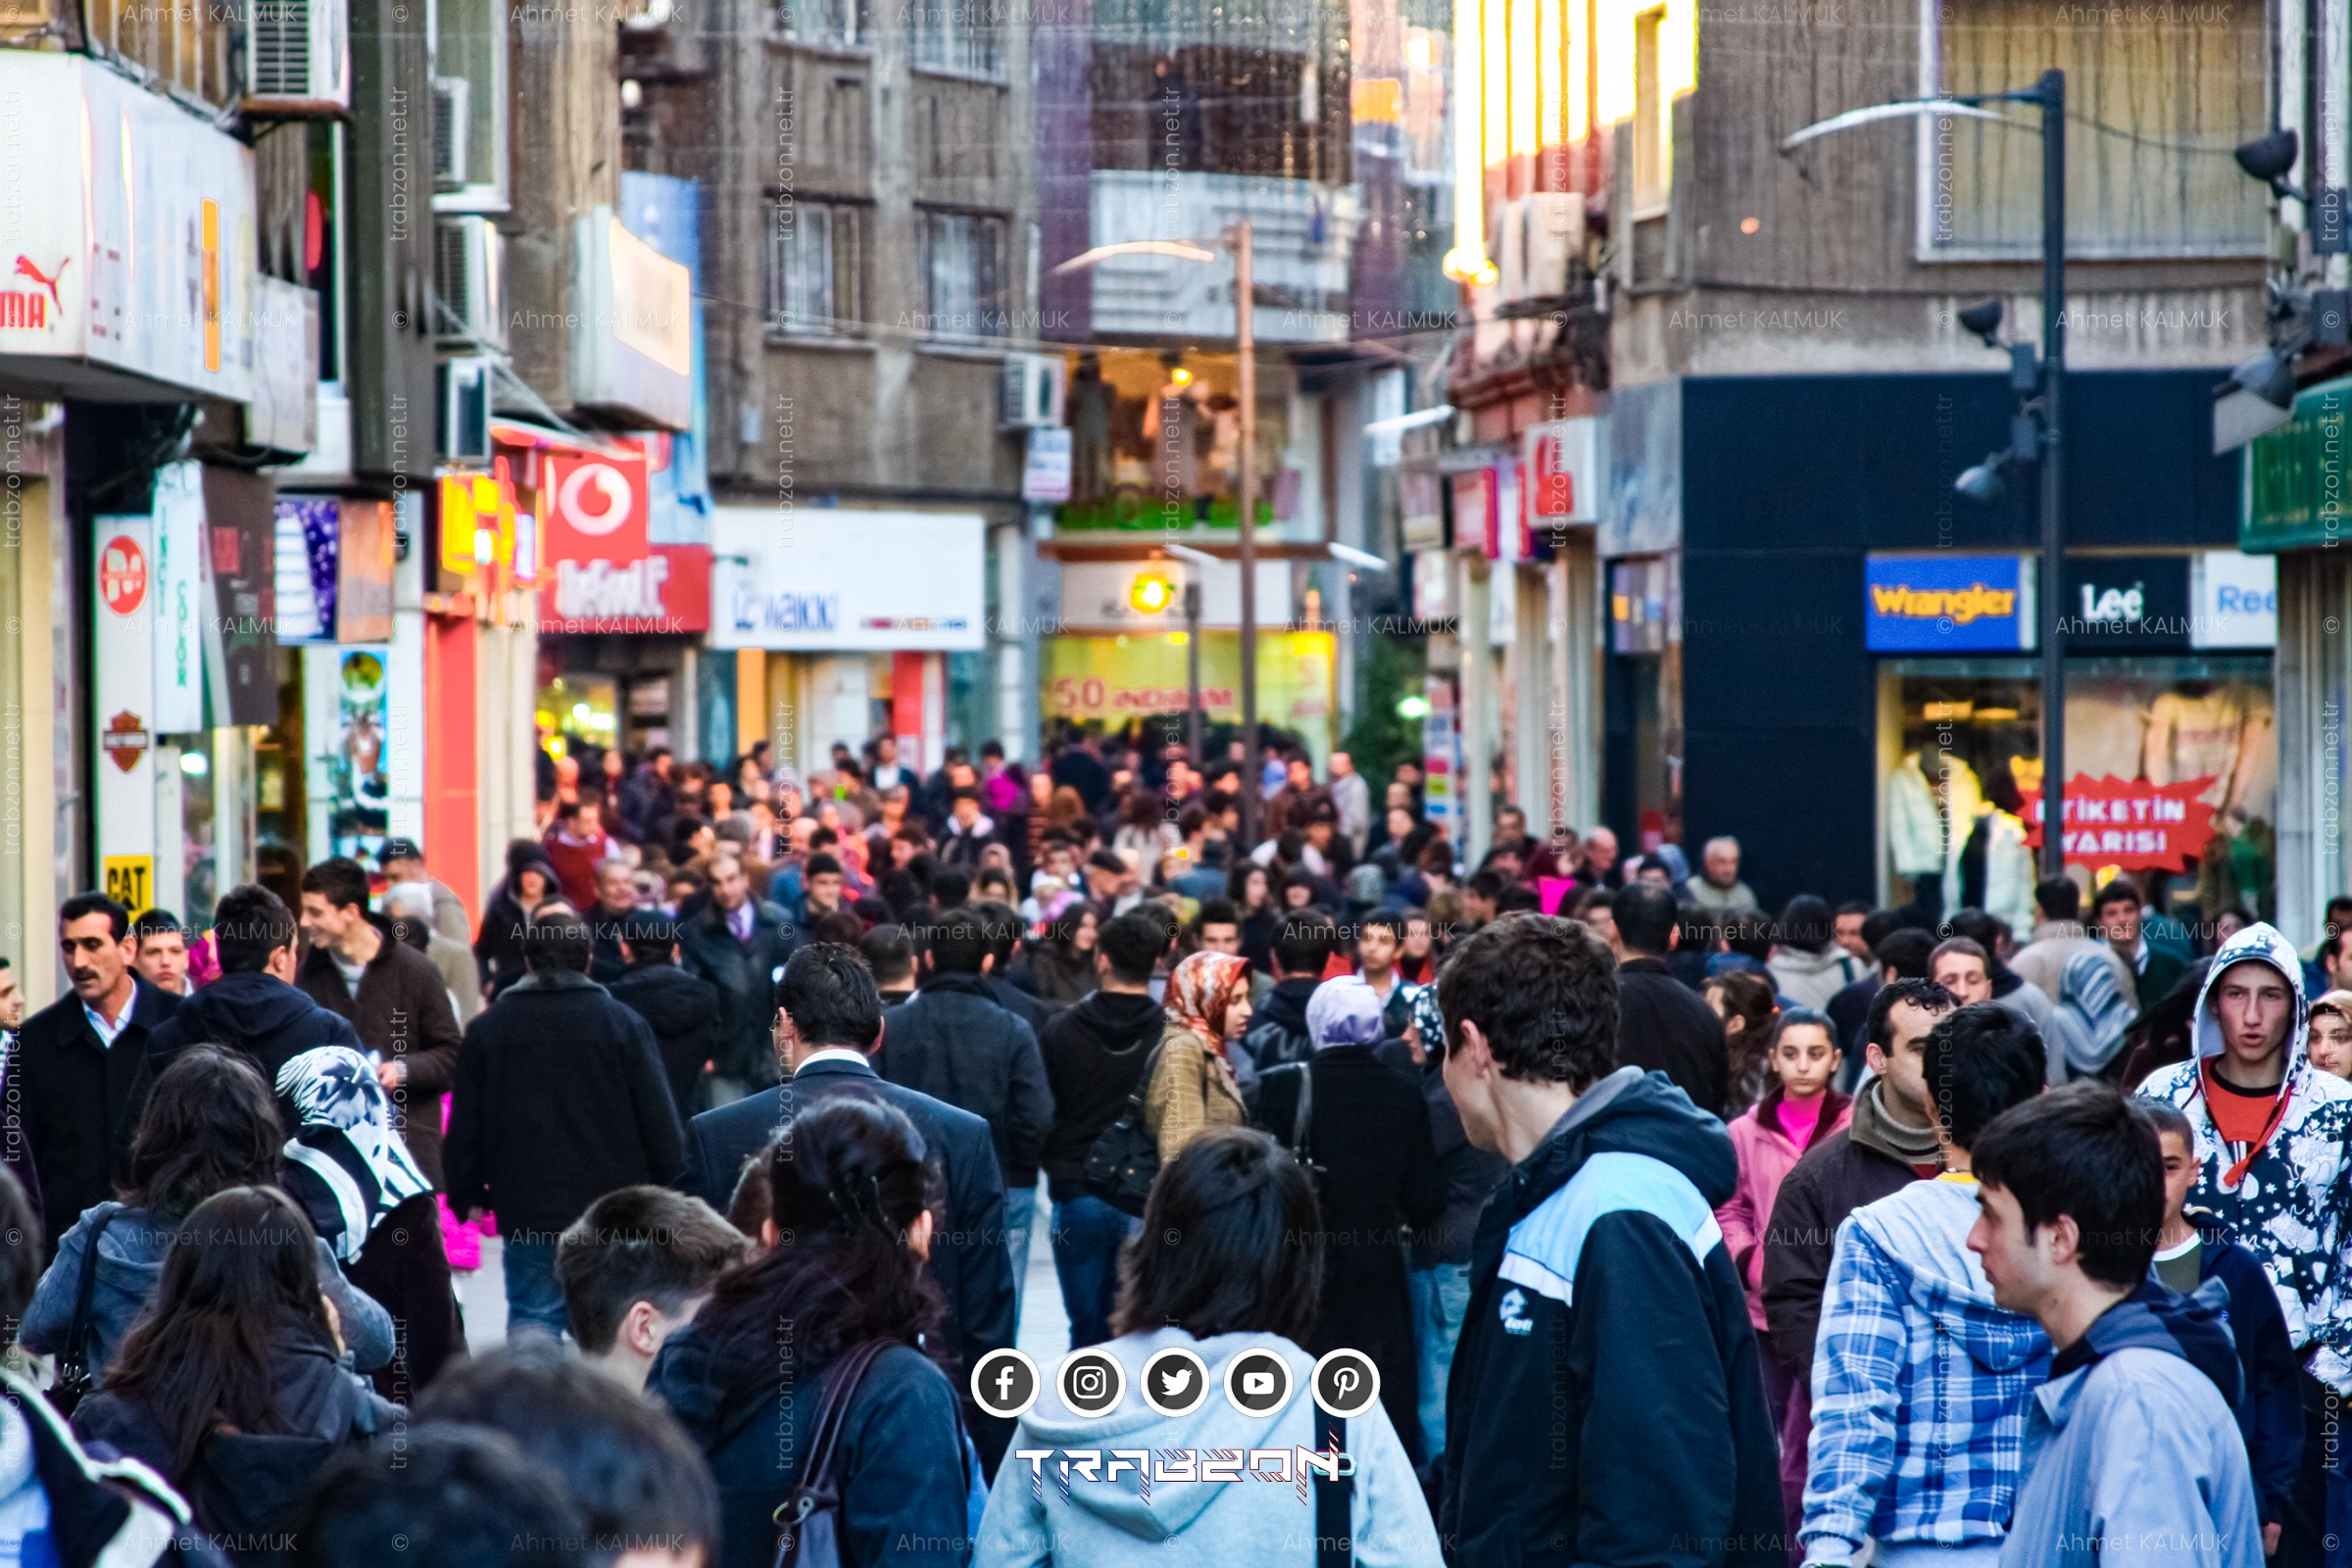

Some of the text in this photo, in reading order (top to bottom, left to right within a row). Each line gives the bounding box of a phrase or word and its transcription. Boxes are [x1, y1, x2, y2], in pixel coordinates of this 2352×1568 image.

[1873, 584, 2016, 625] Wrangler
[2082, 584, 2143, 621] Lee
[107, 865, 145, 909] CAT
